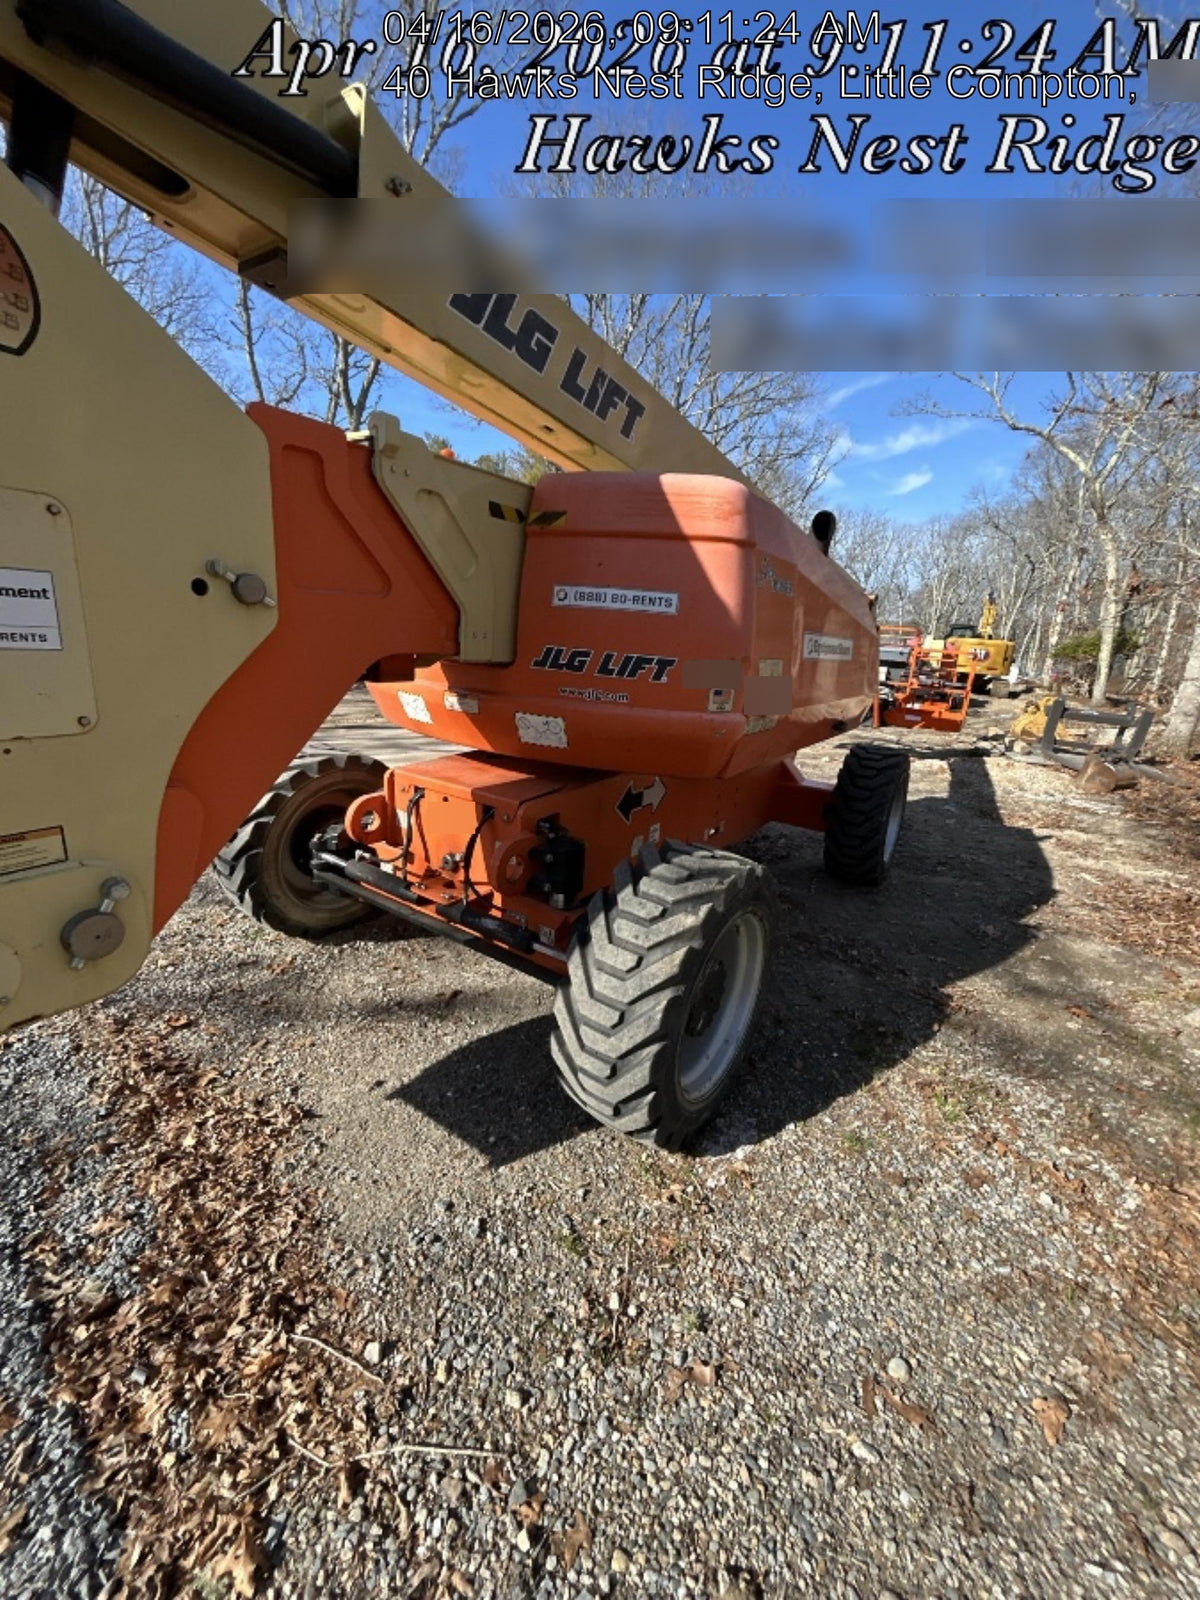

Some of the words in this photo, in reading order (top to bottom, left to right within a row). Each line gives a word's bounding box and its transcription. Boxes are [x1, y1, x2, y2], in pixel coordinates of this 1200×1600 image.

[559, 345, 647, 440] LIFT
[530, 645, 594, 674] JLG
[594, 651, 678, 683] LIFT
